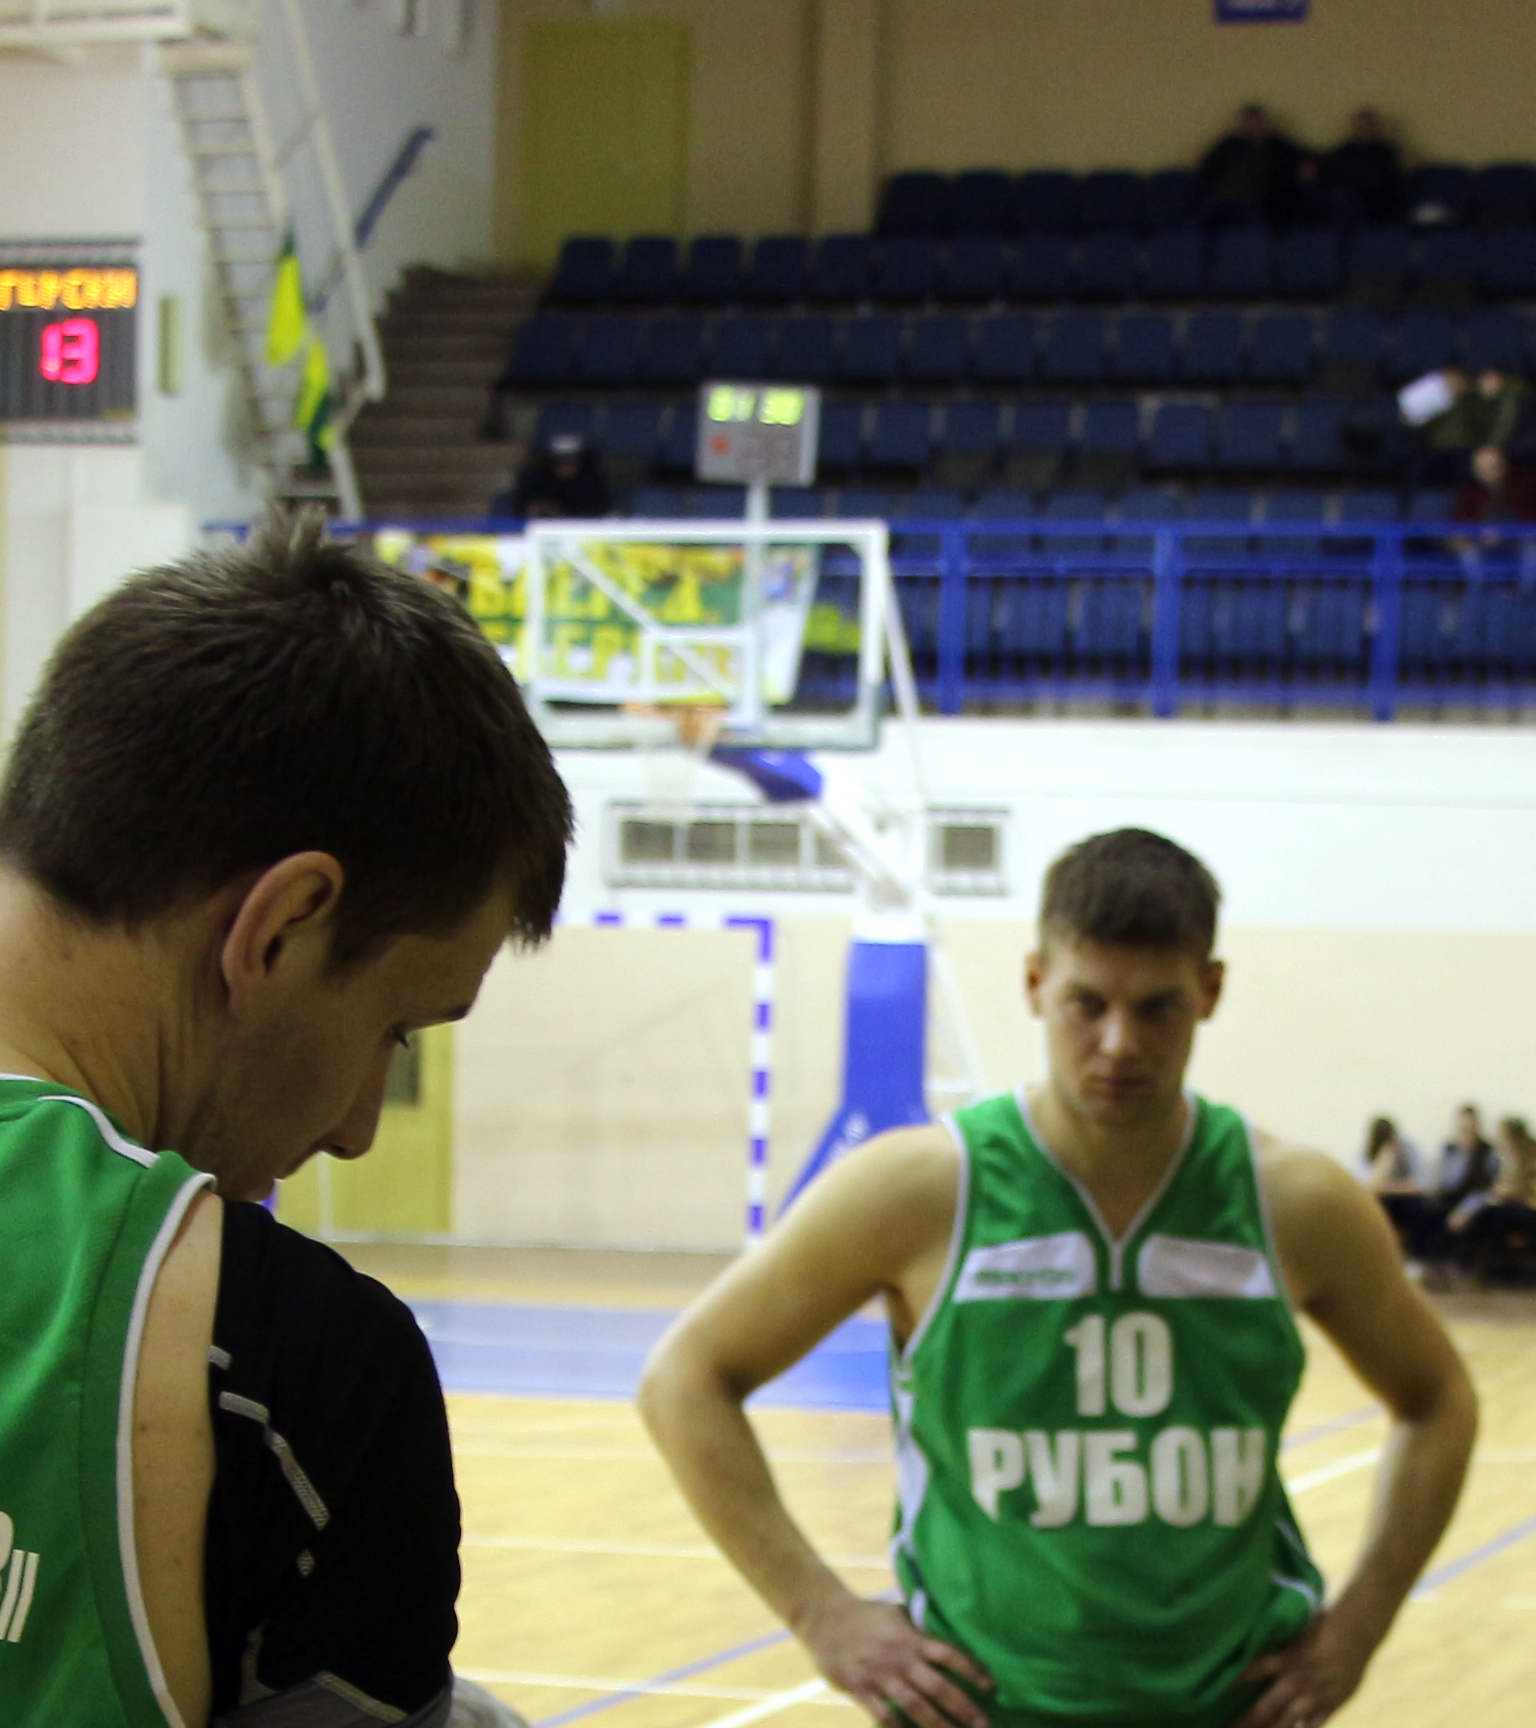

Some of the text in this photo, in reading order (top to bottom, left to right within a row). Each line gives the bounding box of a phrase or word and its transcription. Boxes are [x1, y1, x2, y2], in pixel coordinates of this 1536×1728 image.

[41, 317, 100, 384] 13
[1065, 1312, 1173, 1418] 10
[968, 1426, 1264, 1527] РУБОН
